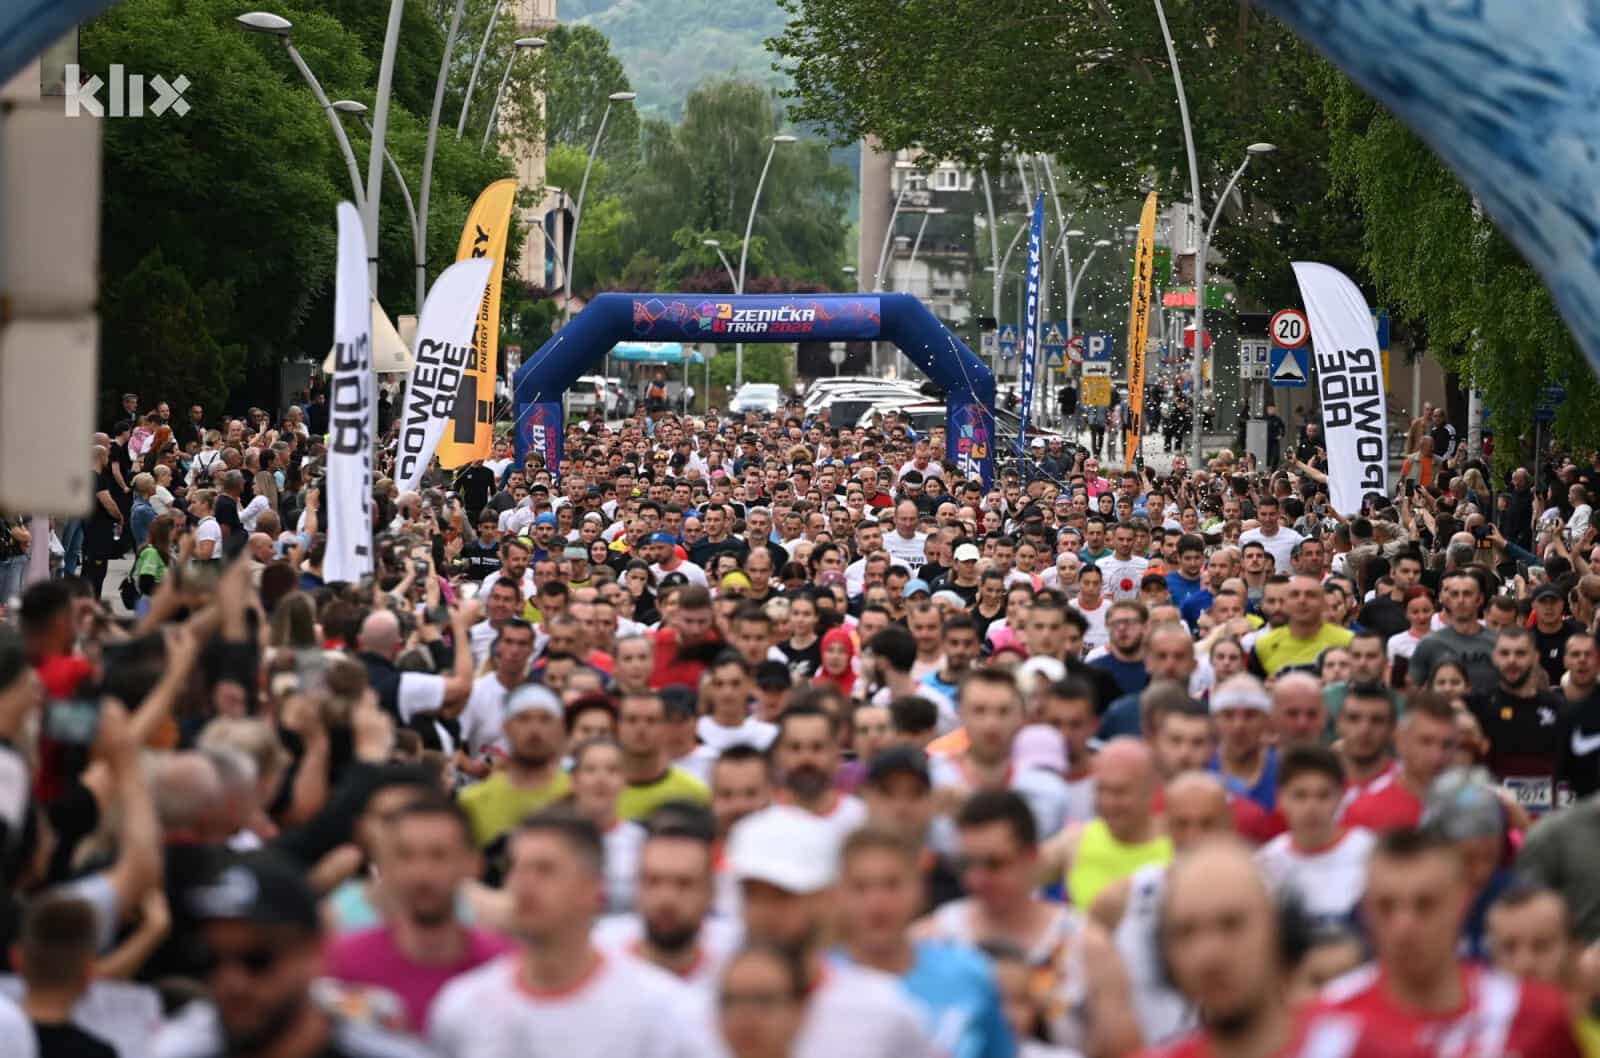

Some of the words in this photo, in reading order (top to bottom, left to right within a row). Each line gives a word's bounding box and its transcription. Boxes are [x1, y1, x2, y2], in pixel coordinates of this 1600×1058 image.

[733, 306, 816, 322] ZENIČKA
[726, 322, 767, 333] TRKA
[1279, 320, 1301, 339] 20
[481, 325, 490, 374] ENERGY
[1089, 336, 1105, 358] P
